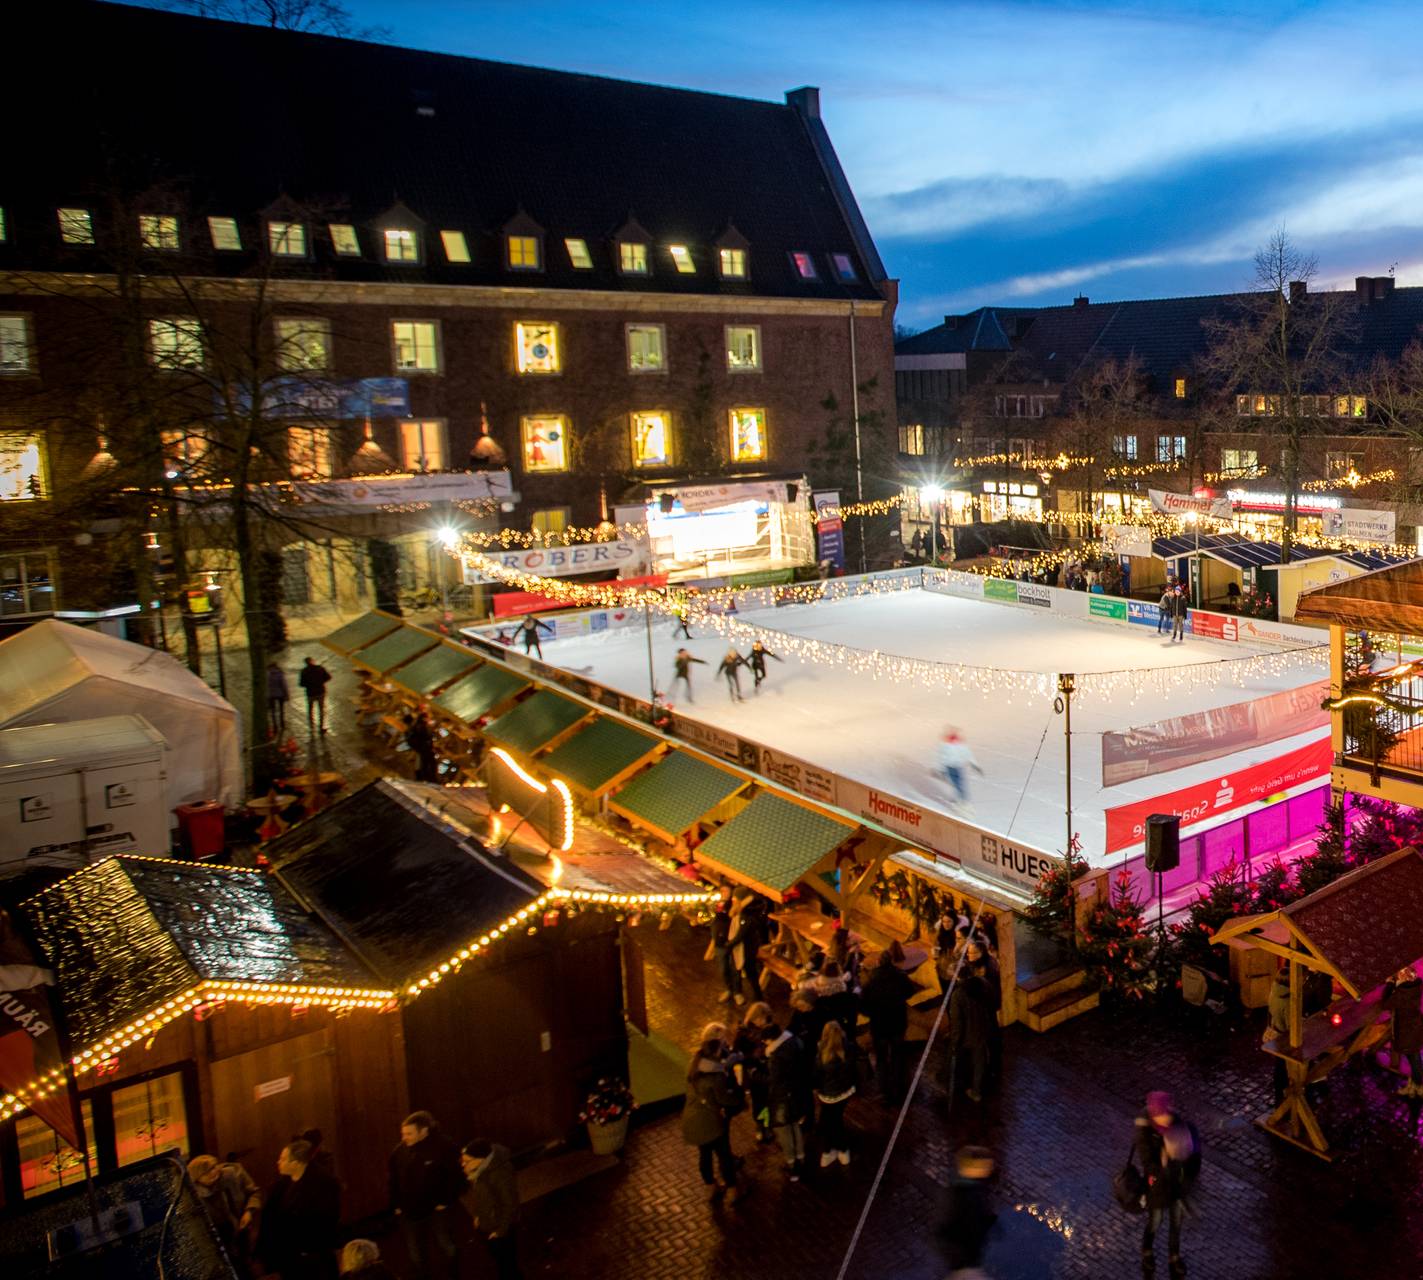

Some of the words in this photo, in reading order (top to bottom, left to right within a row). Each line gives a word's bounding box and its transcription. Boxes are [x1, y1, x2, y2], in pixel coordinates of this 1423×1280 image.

[1163, 492, 1213, 511] Hammer
[1347, 520, 1388, 531] STADTWERKE
[502, 542, 634, 569] ROBERS
[1017, 583, 1051, 599] bockholt
[868, 790, 922, 827] Hammer
[1001, 847, 1056, 880] HUES
